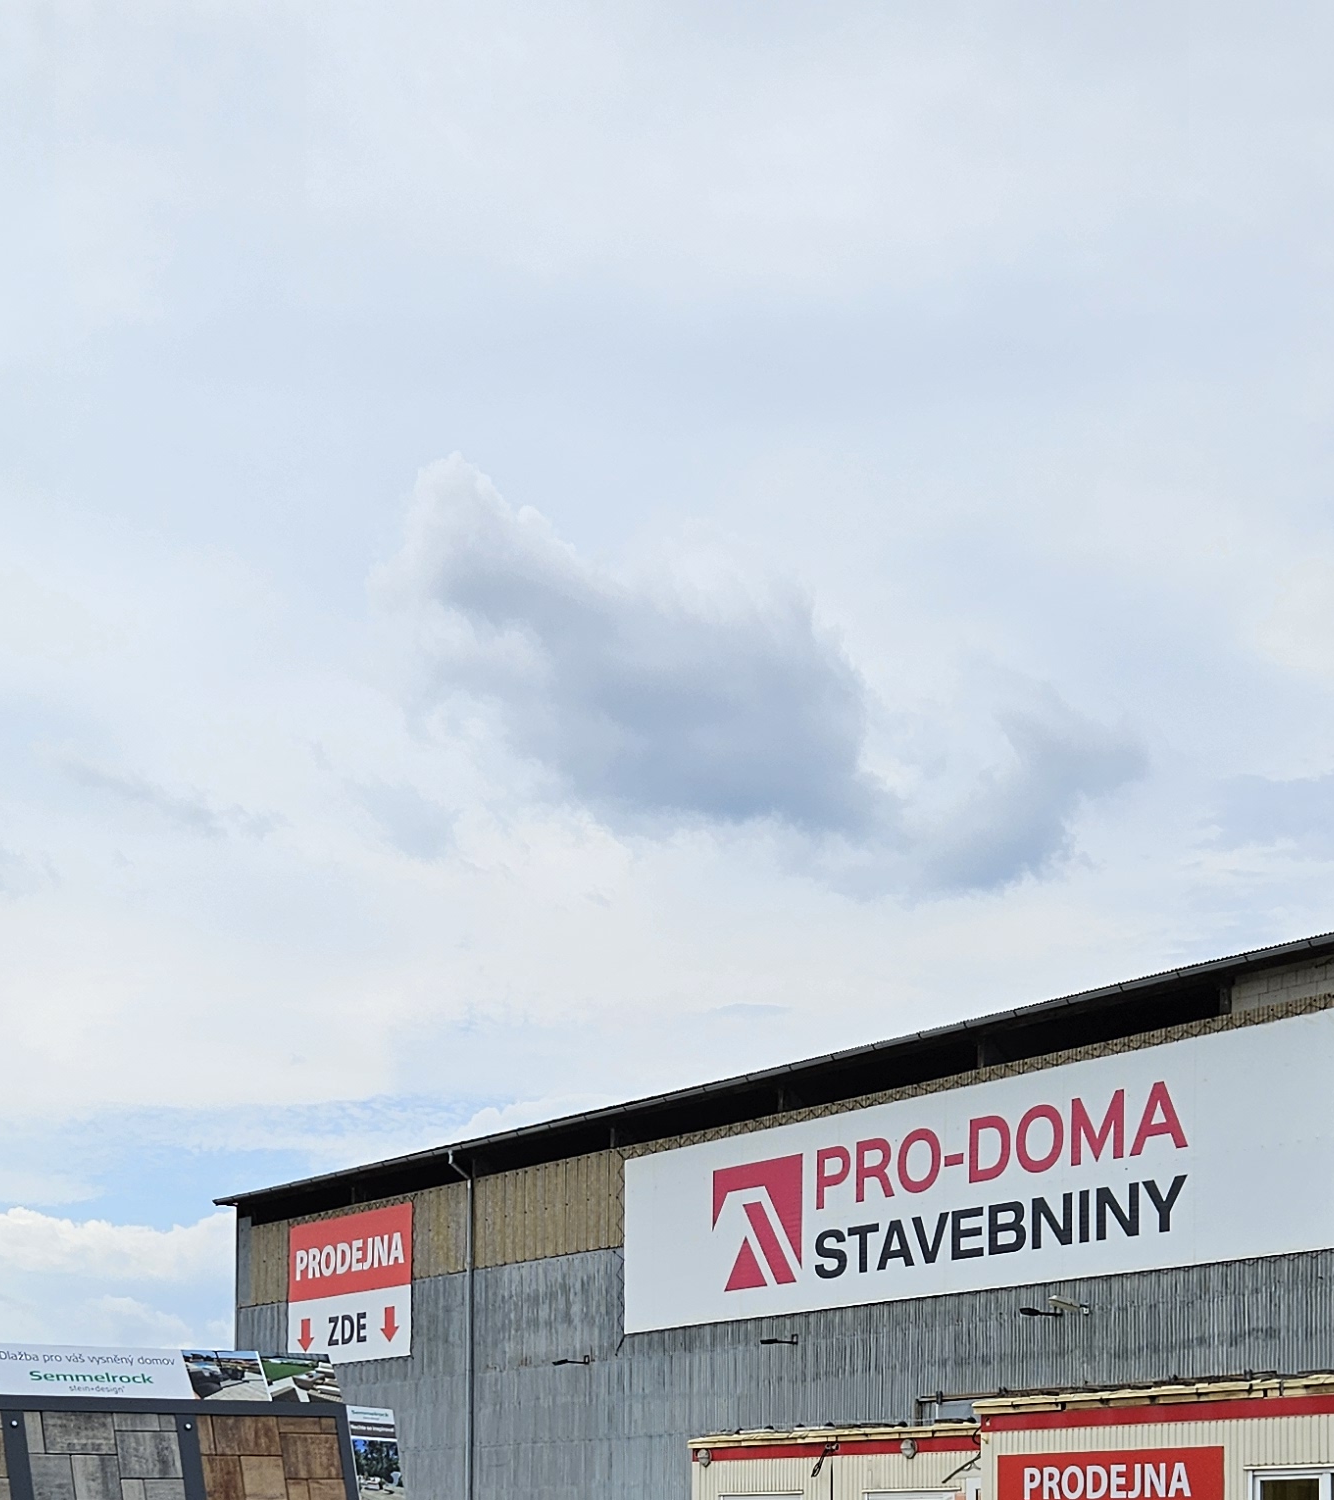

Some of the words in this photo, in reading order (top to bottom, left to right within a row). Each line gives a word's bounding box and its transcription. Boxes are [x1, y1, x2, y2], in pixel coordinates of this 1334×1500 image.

[816, 1080, 1188, 1209] PRO-DOMA
[815, 1174, 1187, 1279] STAVEBNINY
[295, 1232, 404, 1281] PRODEJNA
[327, 1312, 367, 1347] ZDE
[29, 1370, 154, 1384] Semmelrock
[43, 1354, 62, 1363] pro
[67, 1353, 86, 1363] váš
[89, 1354, 134, 1366] vysněný
[137, 1356, 175, 1366] domov
[1023, 1462, 1192, 1500] PRODEJNA
